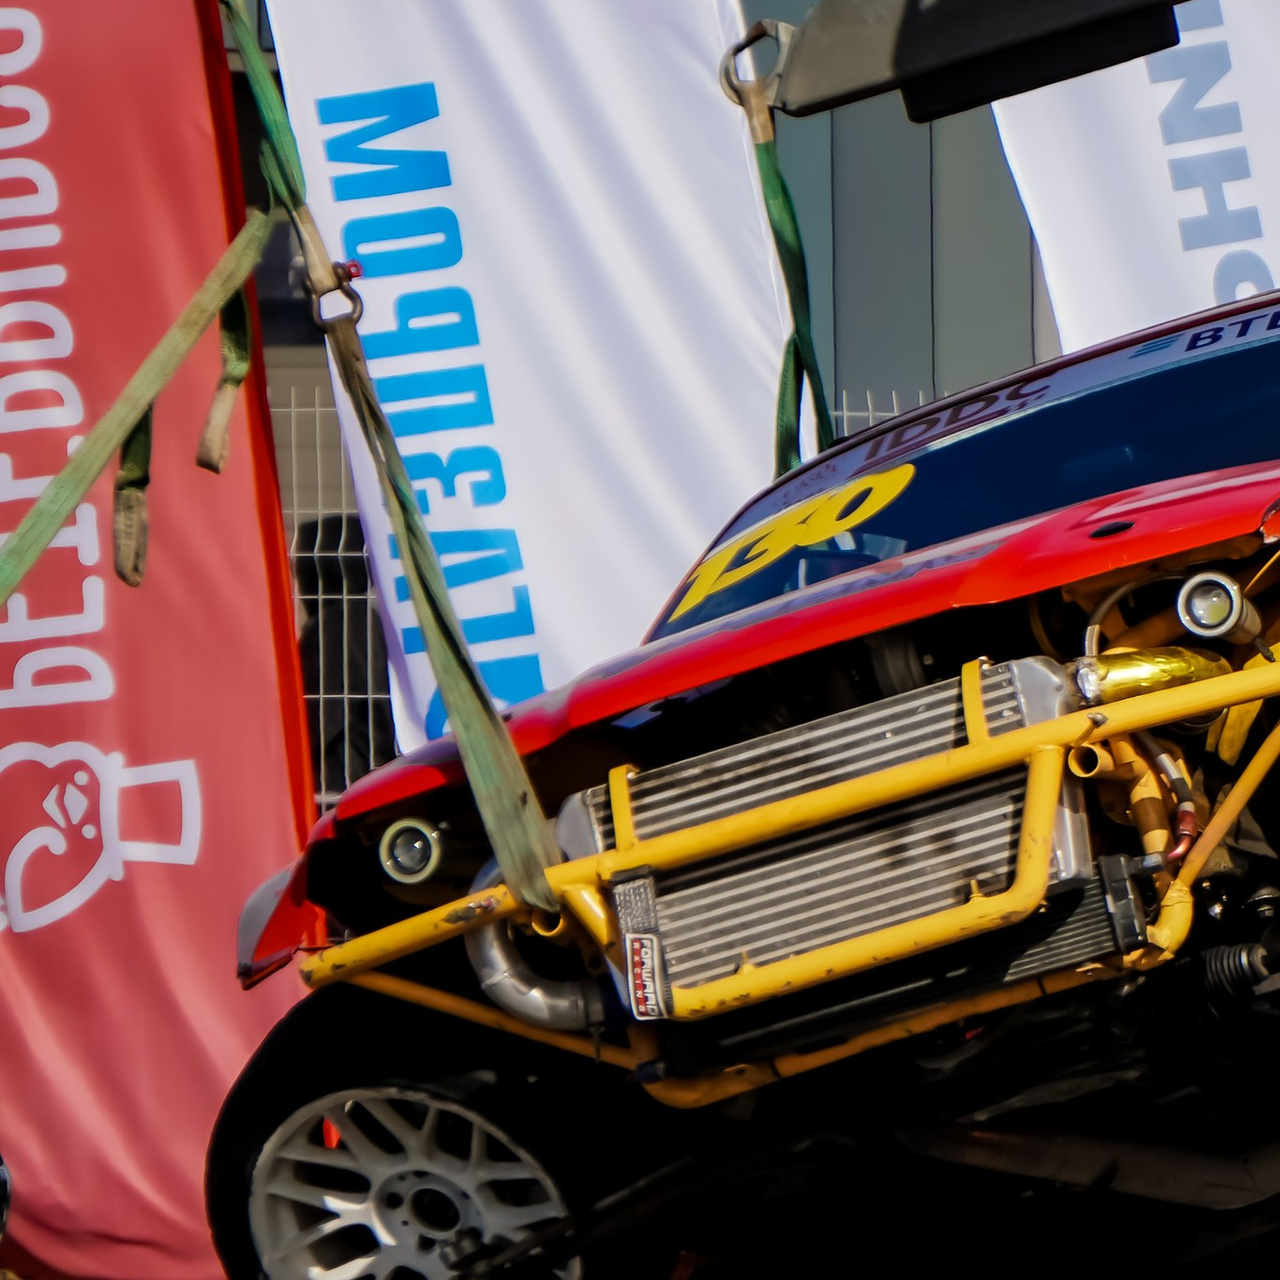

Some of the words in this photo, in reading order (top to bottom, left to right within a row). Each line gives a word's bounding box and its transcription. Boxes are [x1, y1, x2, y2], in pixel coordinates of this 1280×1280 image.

[666, 463, 917, 624] 130
[632, 942, 646, 1012] RACING
[641, 939, 658, 1015] FORWARD
